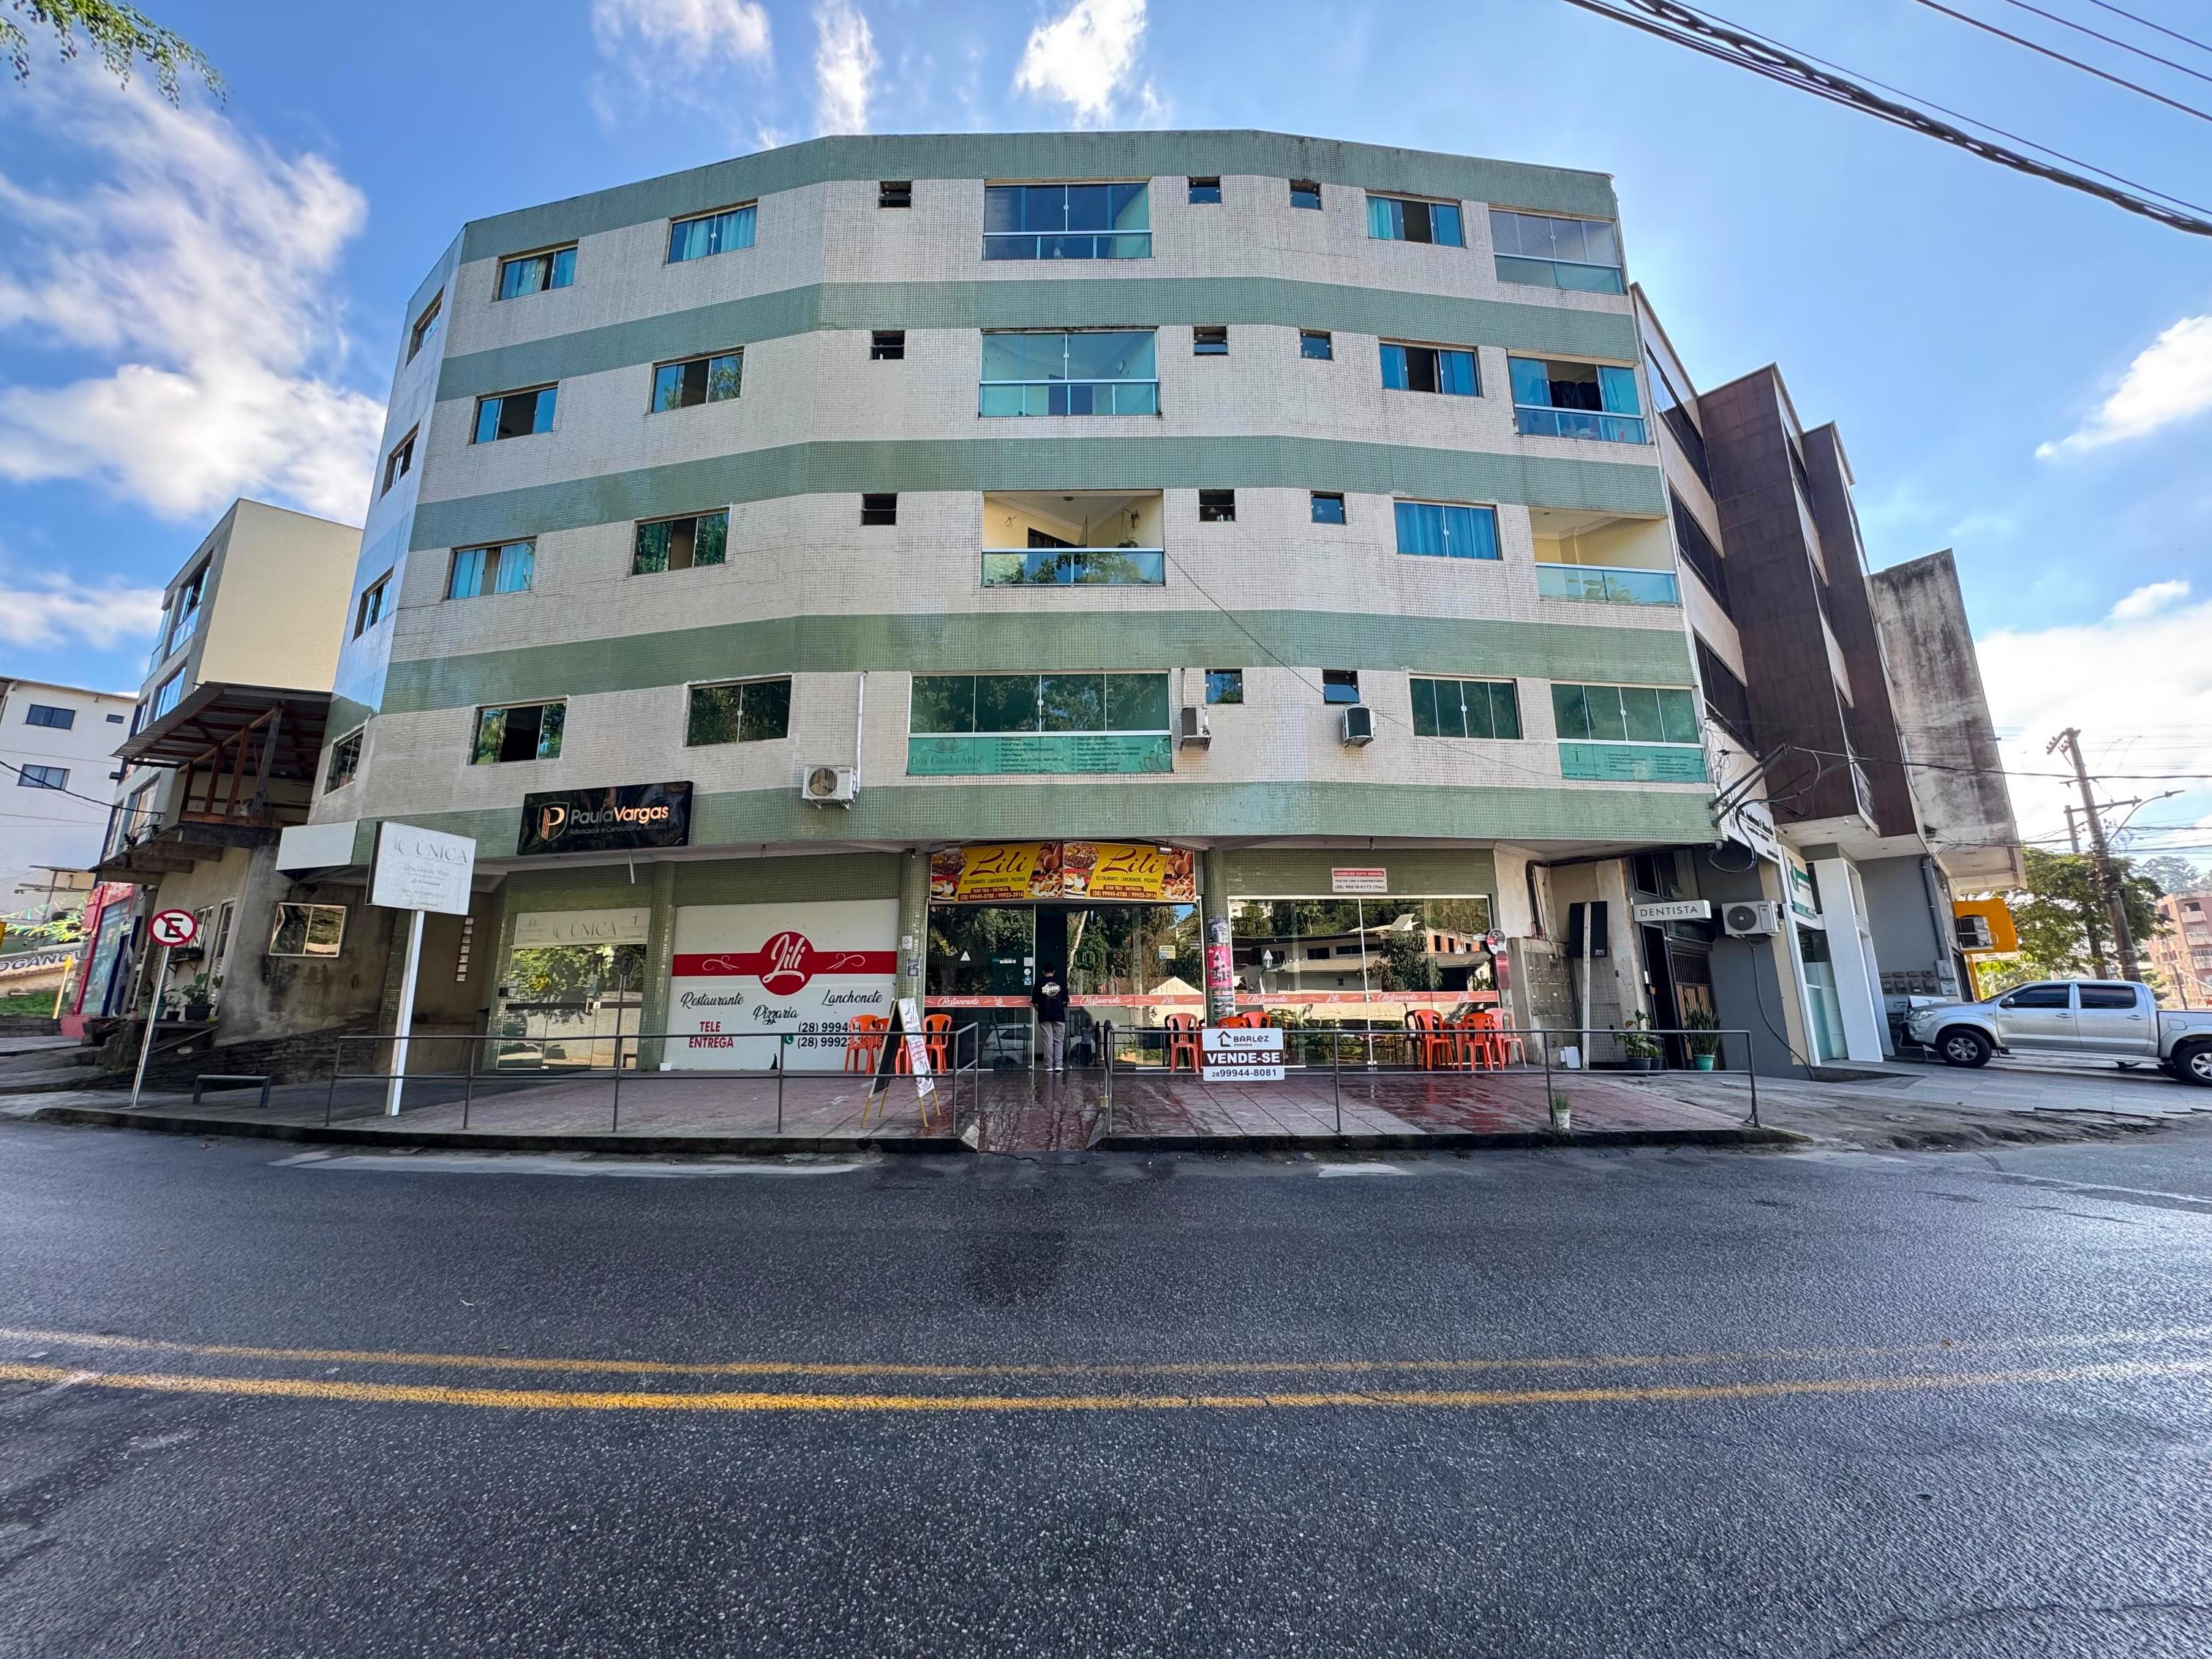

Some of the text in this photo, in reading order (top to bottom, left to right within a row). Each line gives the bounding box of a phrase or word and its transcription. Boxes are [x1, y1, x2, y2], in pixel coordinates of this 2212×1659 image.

[416, 838, 467, 863] ÚNICA
[968, 848, 1028, 876] Lili
[1101, 848, 1161, 874] Lili
[1640, 906, 1698, 917] DENTISTA
[164, 917, 184, 938] E
[571, 919, 617, 937] ÚNICA
[762, 933, 807, 984] Lili
[680, 990, 884, 1009] Restaurante Lanchonete
[753, 1004, 799, 1026] Pizzaria
[699, 1021, 721, 1032] TELE
[798, 1022, 819, 1033] (28)
[688, 1037, 734, 1048] ENTREGA
[797, 1037, 819, 1050] (28)
[1206, 1052, 1281, 1064] VENDE-SE
